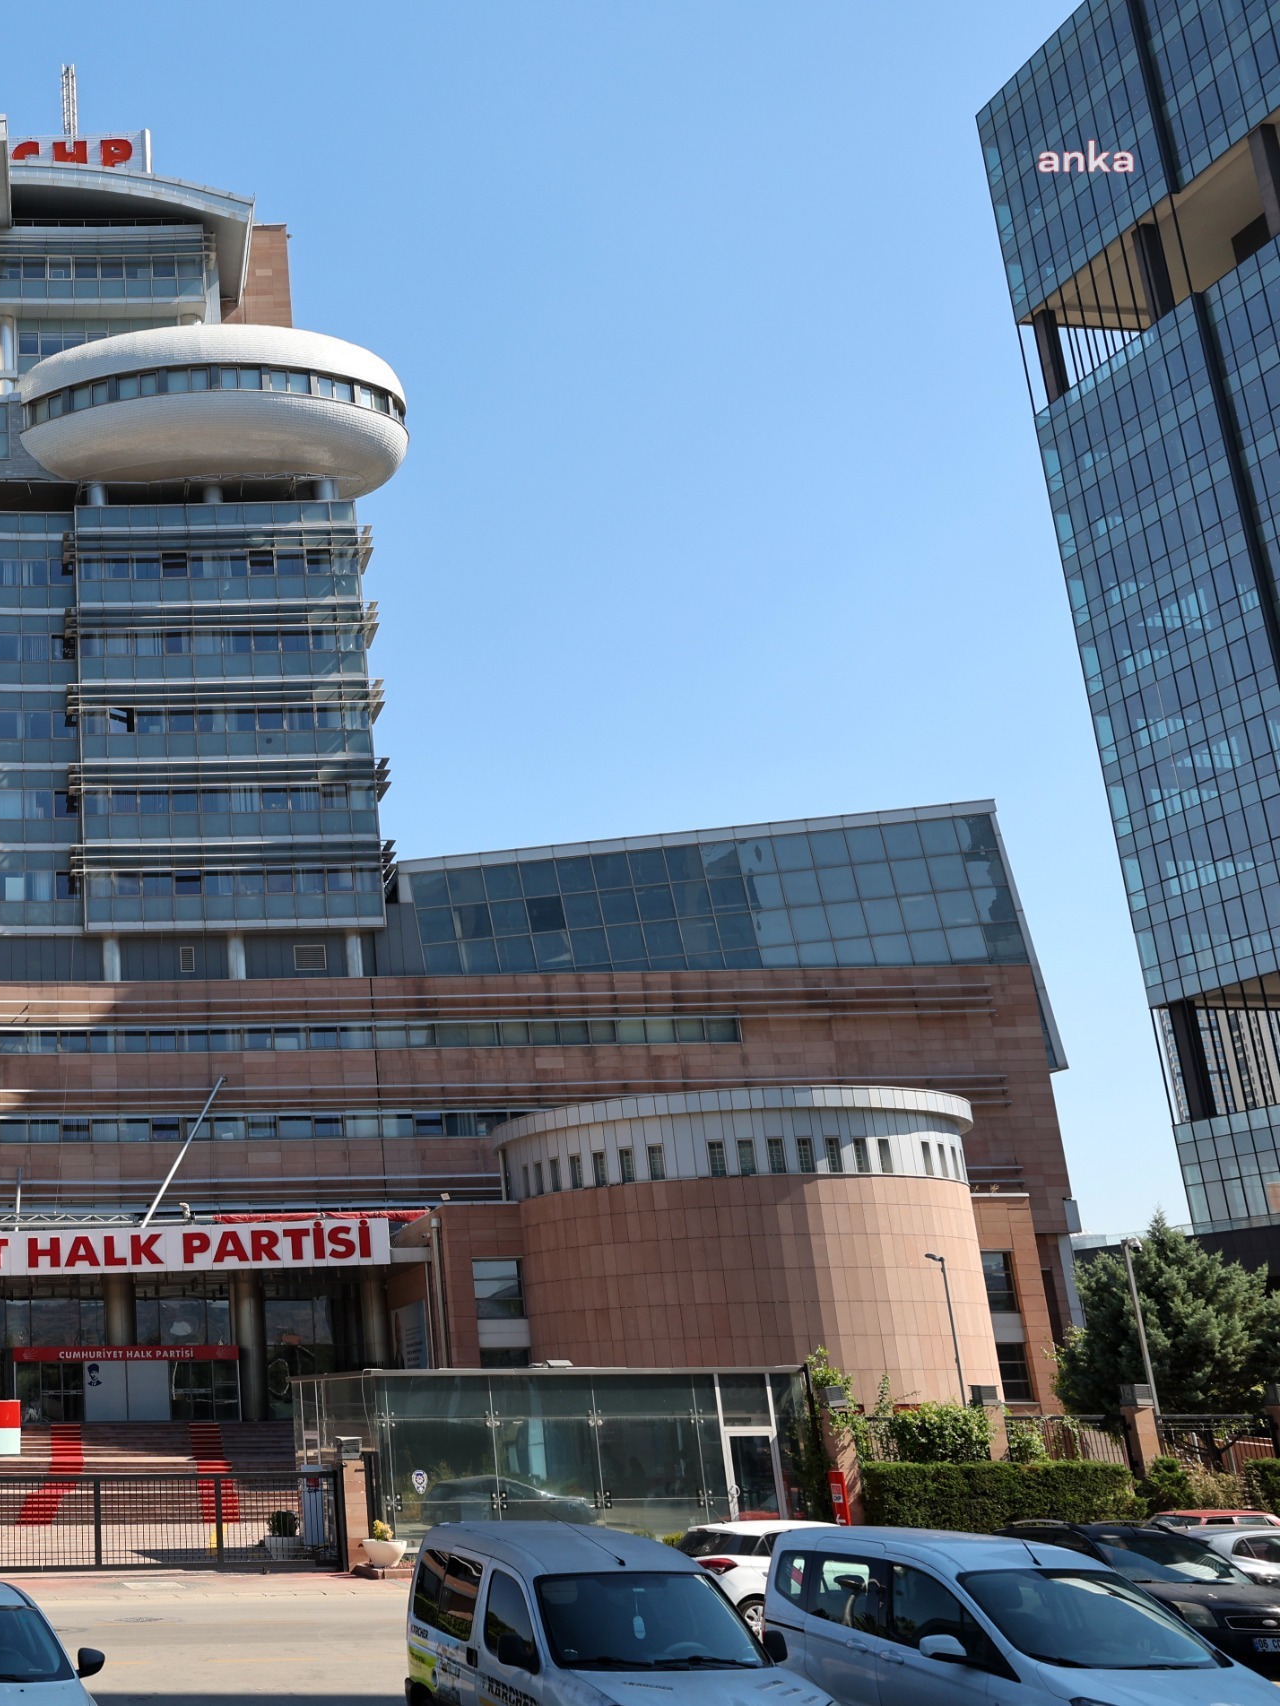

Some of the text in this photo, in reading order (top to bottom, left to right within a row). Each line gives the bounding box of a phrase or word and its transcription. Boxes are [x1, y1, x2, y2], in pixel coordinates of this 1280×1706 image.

[27, 1233, 165, 1269] HALK
[182, 1220, 372, 1264] PARTİSİ
[59, 1348, 194, 1359] CUMHURİYET HALK PARTİSİ
